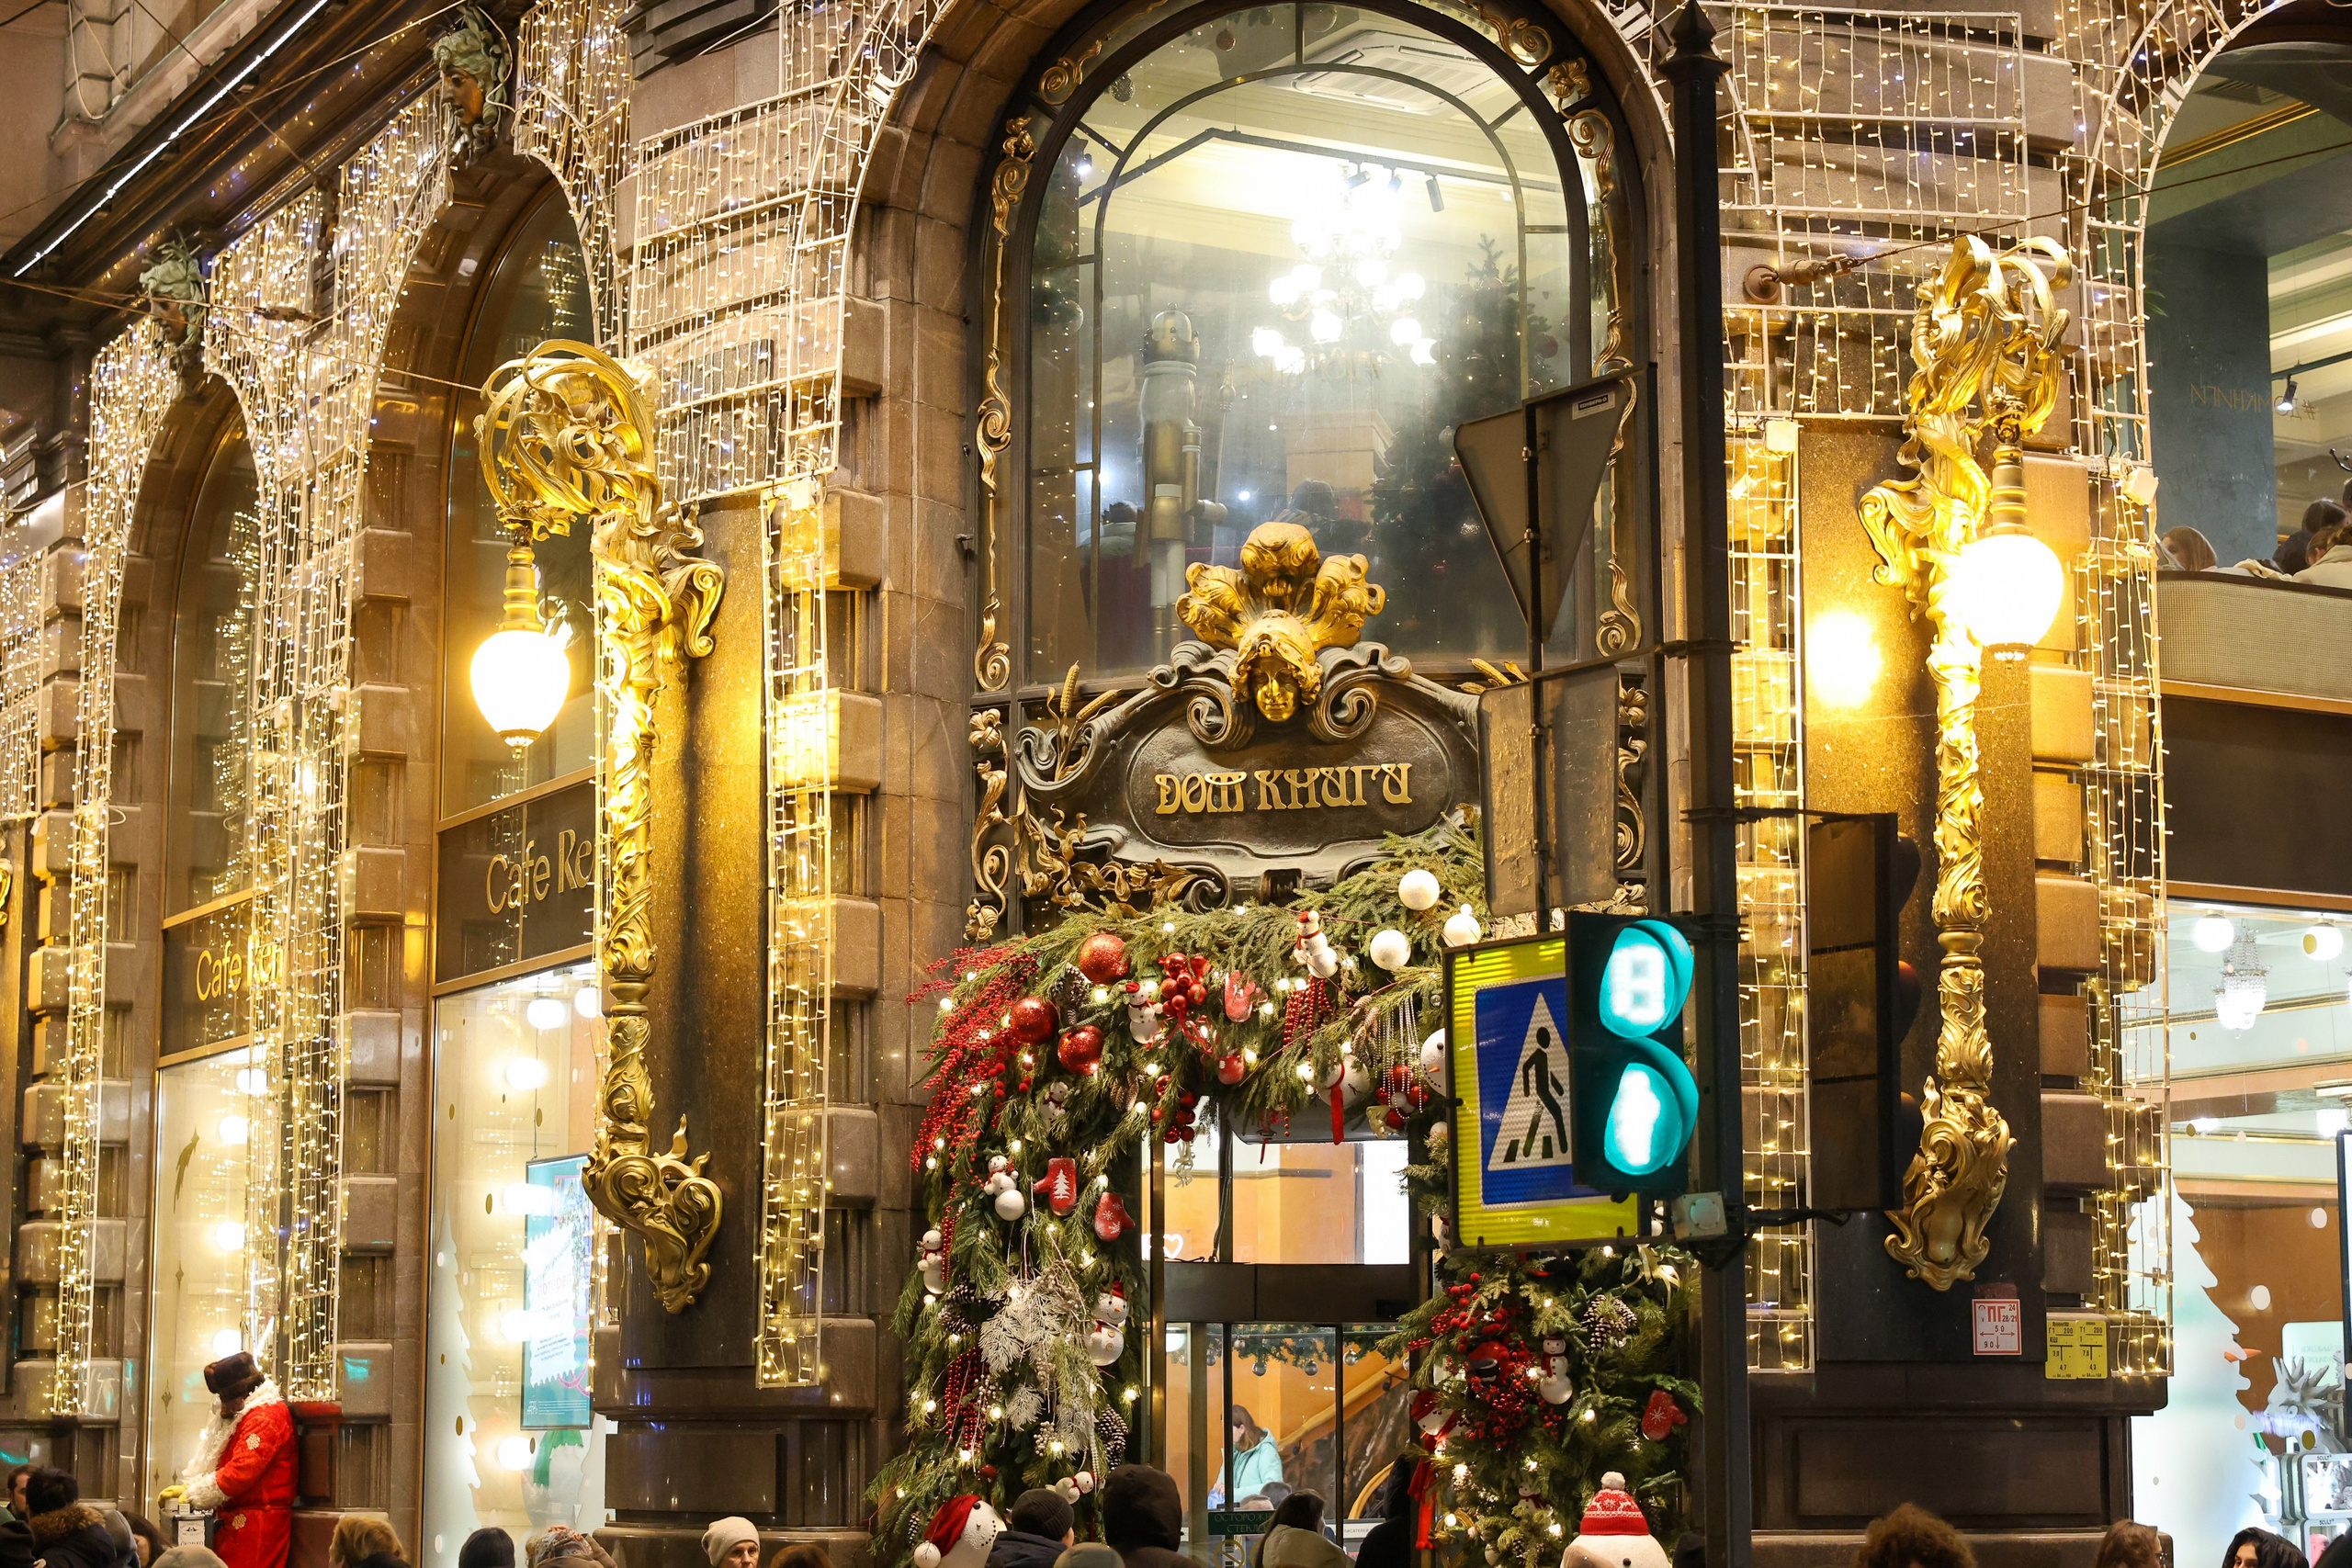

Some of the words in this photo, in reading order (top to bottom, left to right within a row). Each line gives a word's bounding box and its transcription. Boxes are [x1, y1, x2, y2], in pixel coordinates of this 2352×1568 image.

[1155, 771, 1247, 815] ДОМ
[1253, 762, 1413, 811] КНИГИ
[486, 840, 551, 915] Cafe
[557, 829, 595, 895] Re
[196, 940, 243, 1002] Cafe
[246, 932, 285, 988] Ren
[1987, 1305, 2007, 1323] ПГ
[2008, 1303, 2016, 1312] 24
[1214, 1512, 1273, 1523] ОСТОРОЖН
